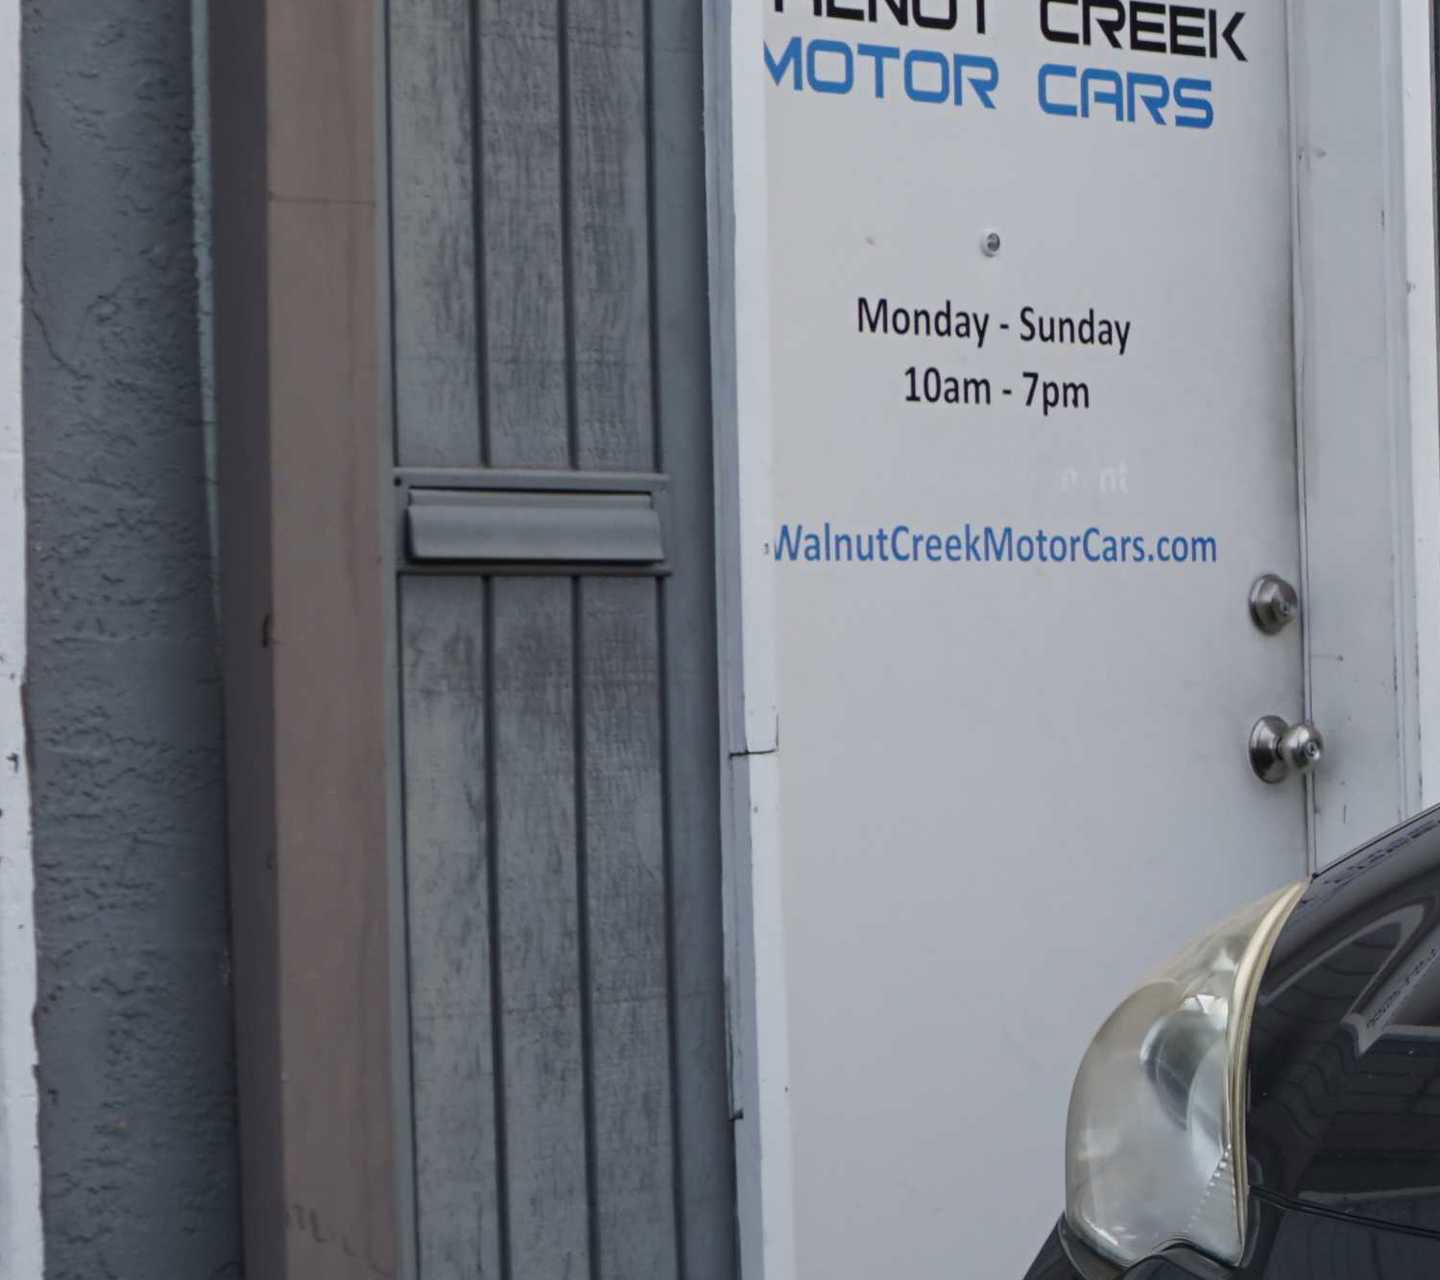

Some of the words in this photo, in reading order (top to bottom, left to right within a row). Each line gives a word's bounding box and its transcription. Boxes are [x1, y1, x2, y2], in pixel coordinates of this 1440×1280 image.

[763, 36, 999, 109] MOTOR
[1036, 63, 1214, 129] CARS
[856, 296, 990, 349] Monday
[1019, 305, 1131, 356] Sunday
[904, 366, 992, 406] 10am
[1022, 371, 1090, 417] 7pm
[773, 522, 1217, 565] WalnutCreekMotorCars.com
